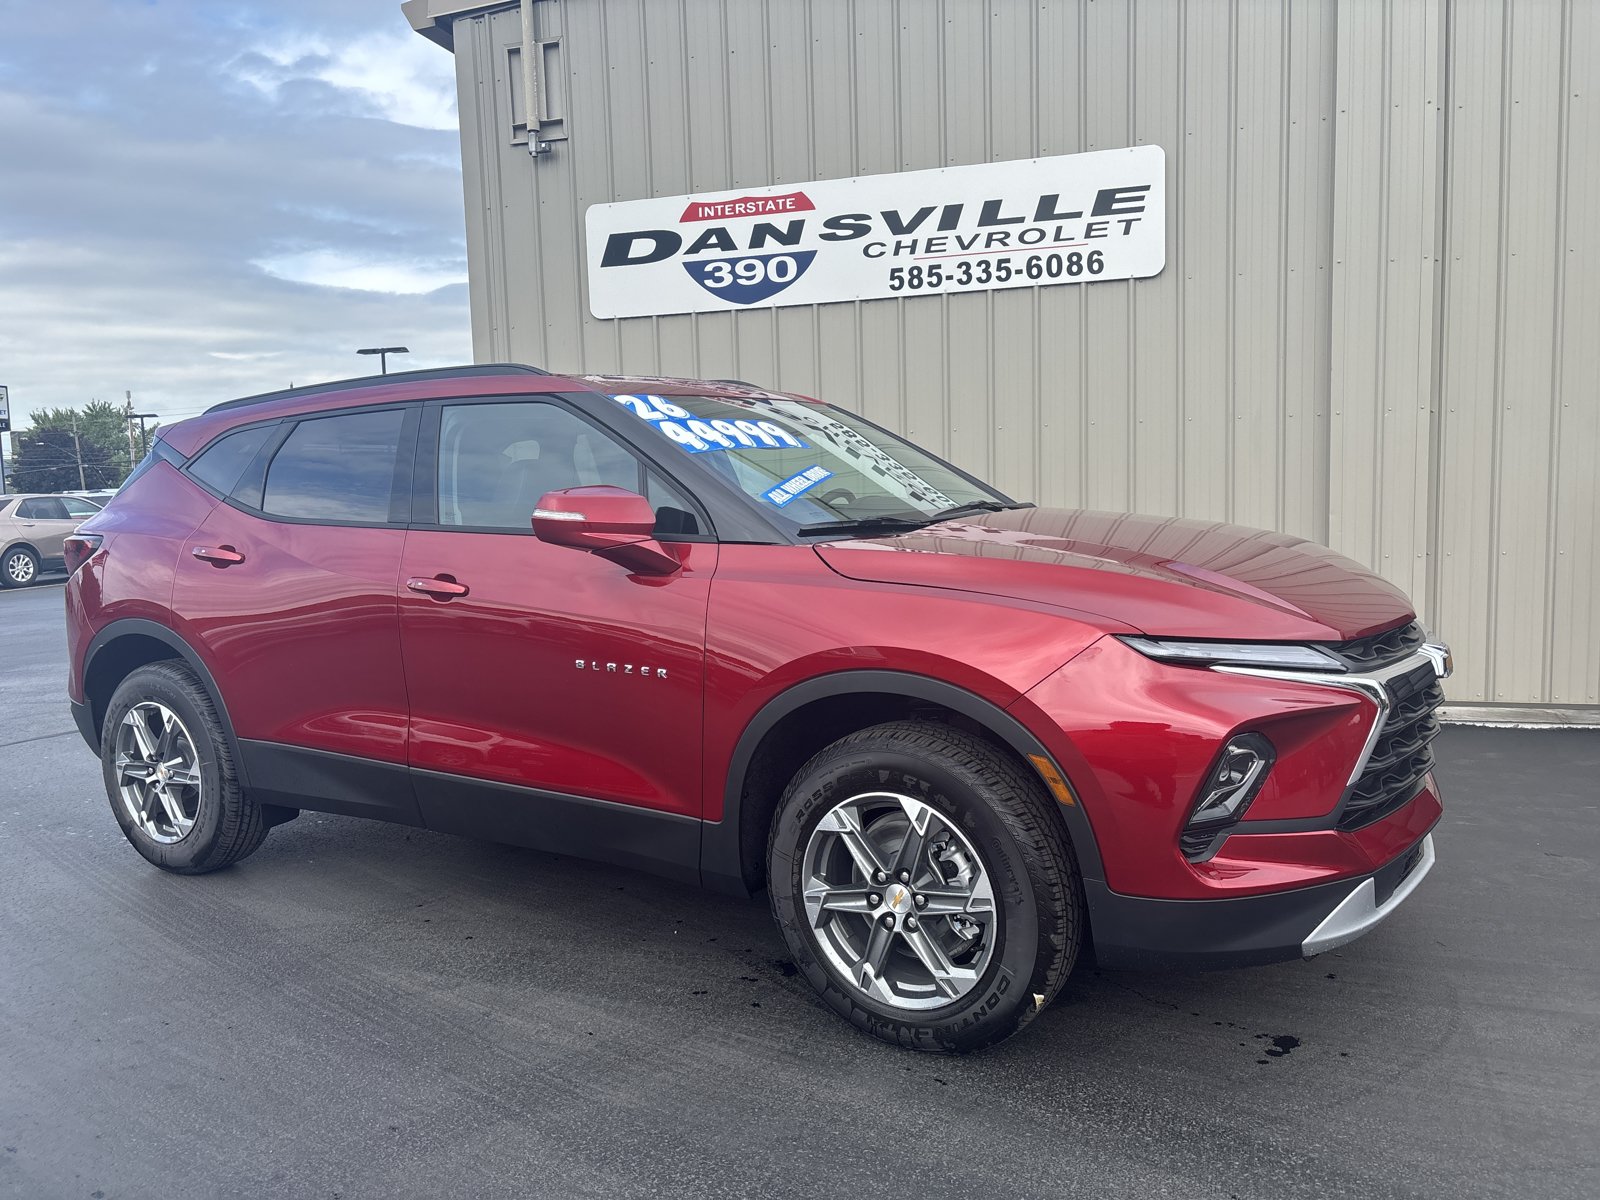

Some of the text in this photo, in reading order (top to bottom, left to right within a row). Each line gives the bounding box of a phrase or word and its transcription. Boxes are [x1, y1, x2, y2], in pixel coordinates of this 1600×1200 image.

[697, 198, 796, 218] INTERSTATE
[862, 217, 1142, 259] CHEVROLET
[703, 255, 798, 288] 390
[888, 250, 1105, 291] 585-335-6086
[614, 395, 690, 420] 26
[659, 420, 803, 450] 44999
[767, 488, 793, 504] ALL
[780, 475, 815, 495] WHEEL
[575, 659, 668, 679] BLAZER
